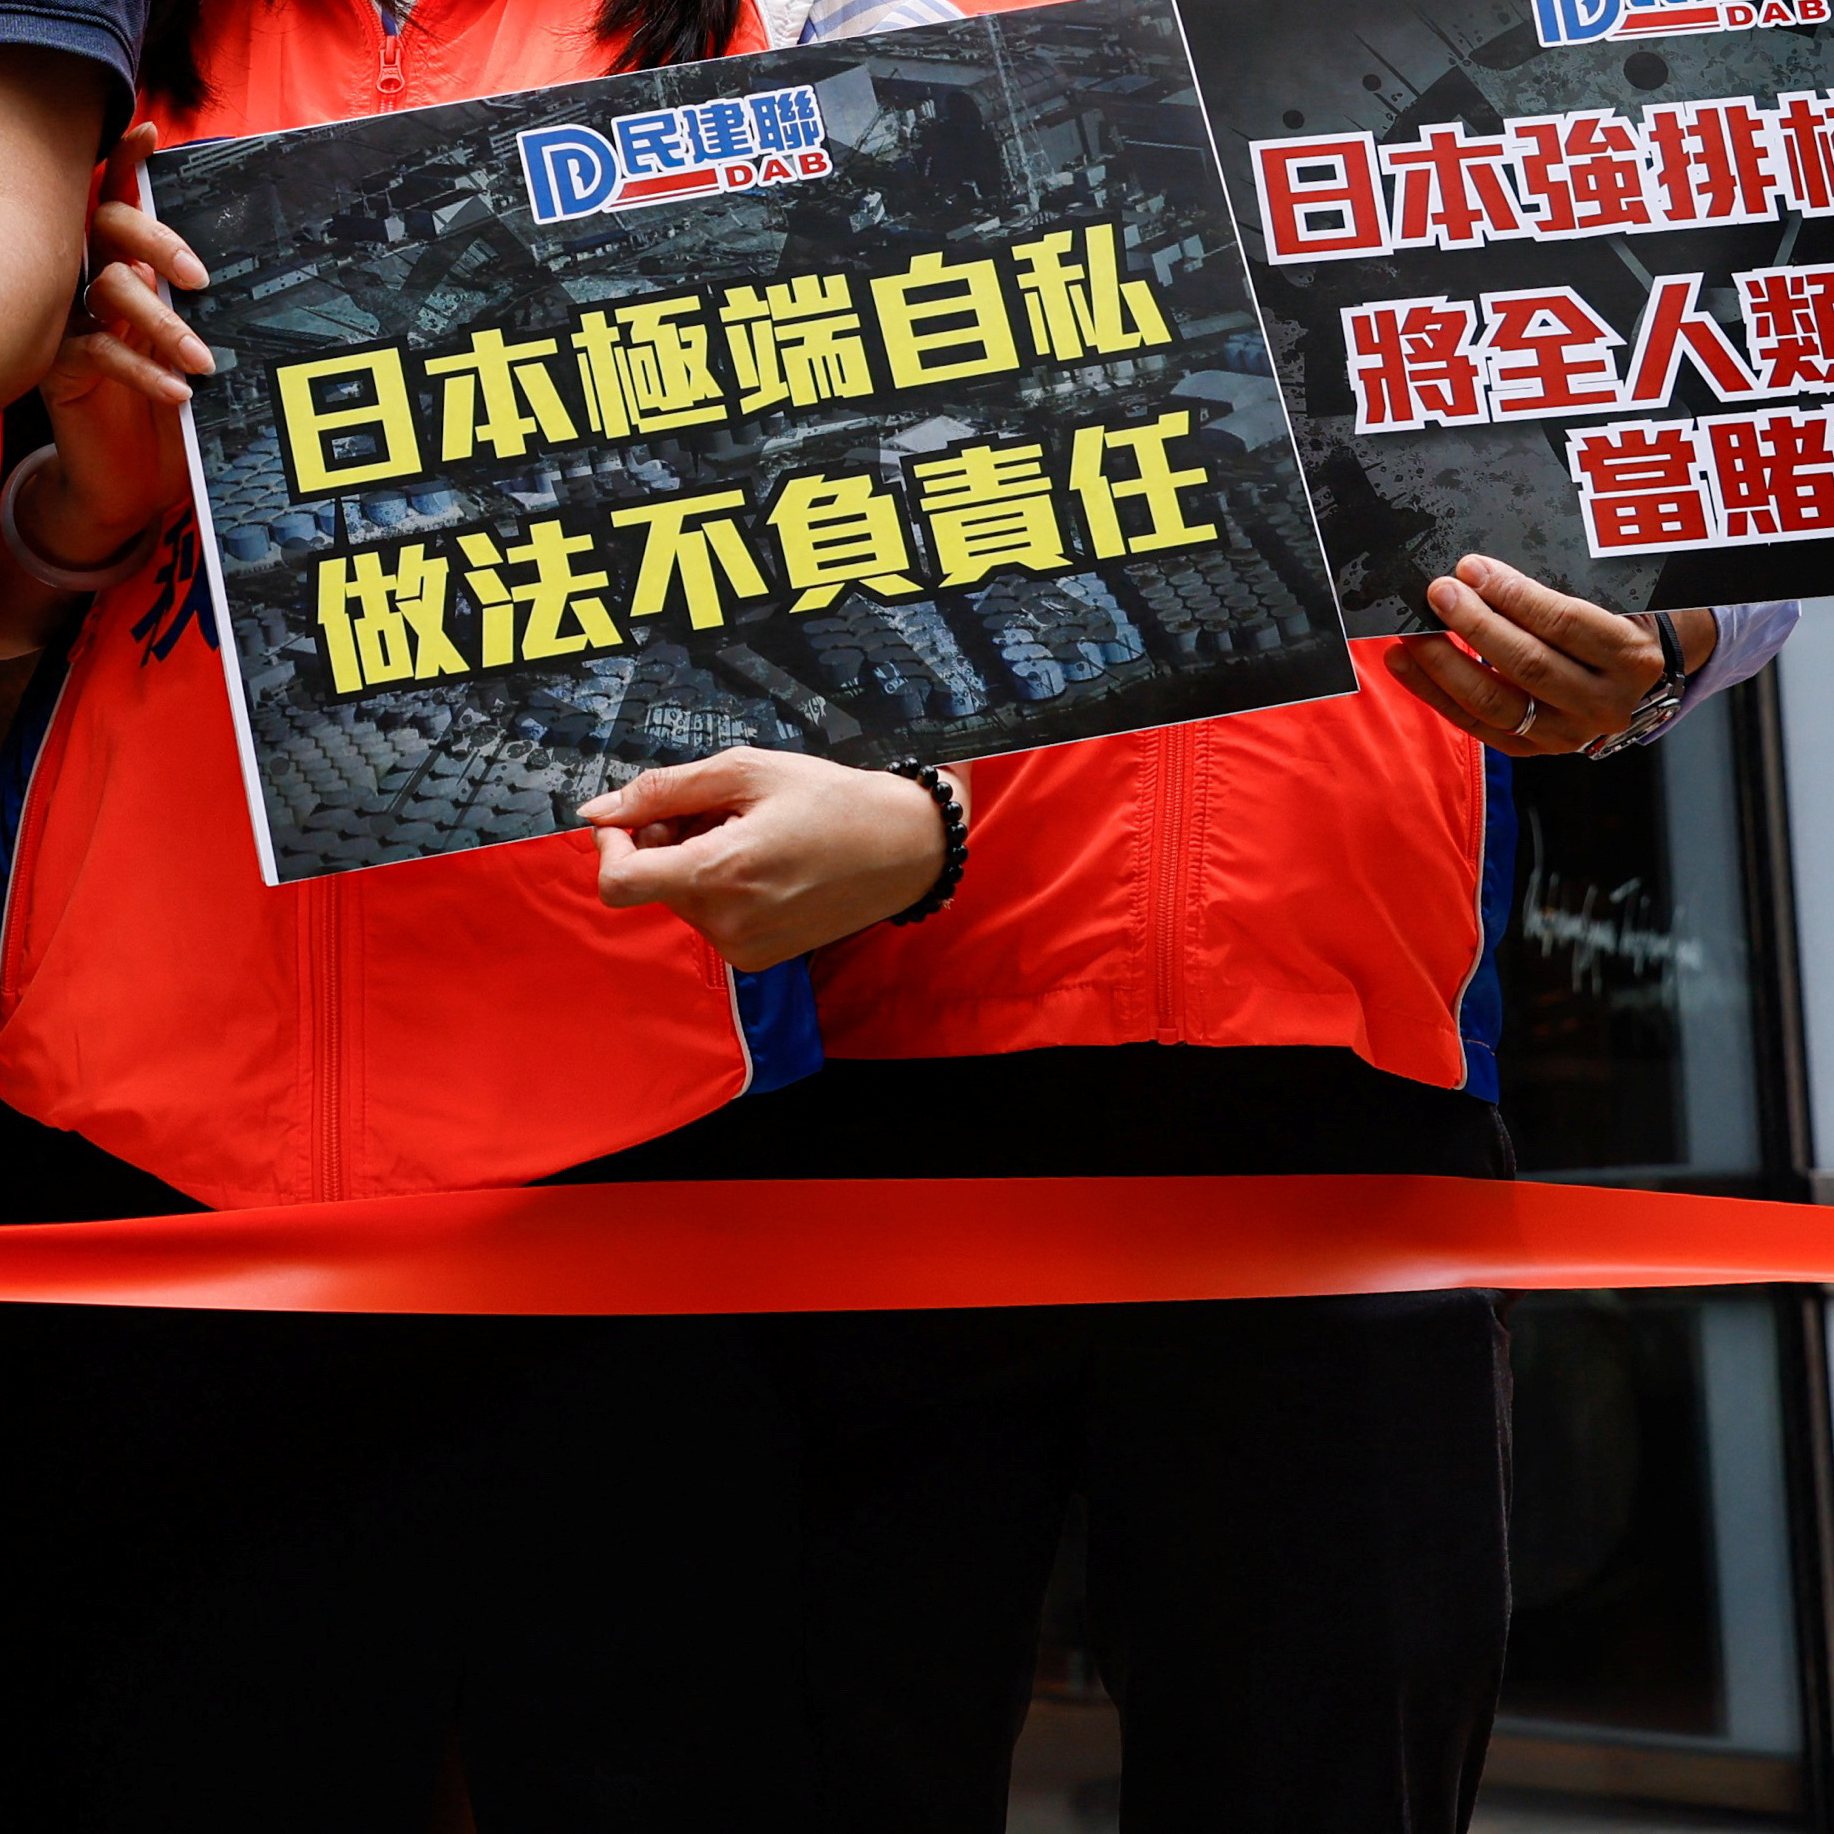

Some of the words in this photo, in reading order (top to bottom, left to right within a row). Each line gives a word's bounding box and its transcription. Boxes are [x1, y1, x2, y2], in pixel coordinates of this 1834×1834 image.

[615, 88, 820, 175] 民建聯
[724, 151, 829, 188] DAB
[276, 222, 1173, 496] 日本極端自私
[316, 409, 1218, 694] 做法不負責任
